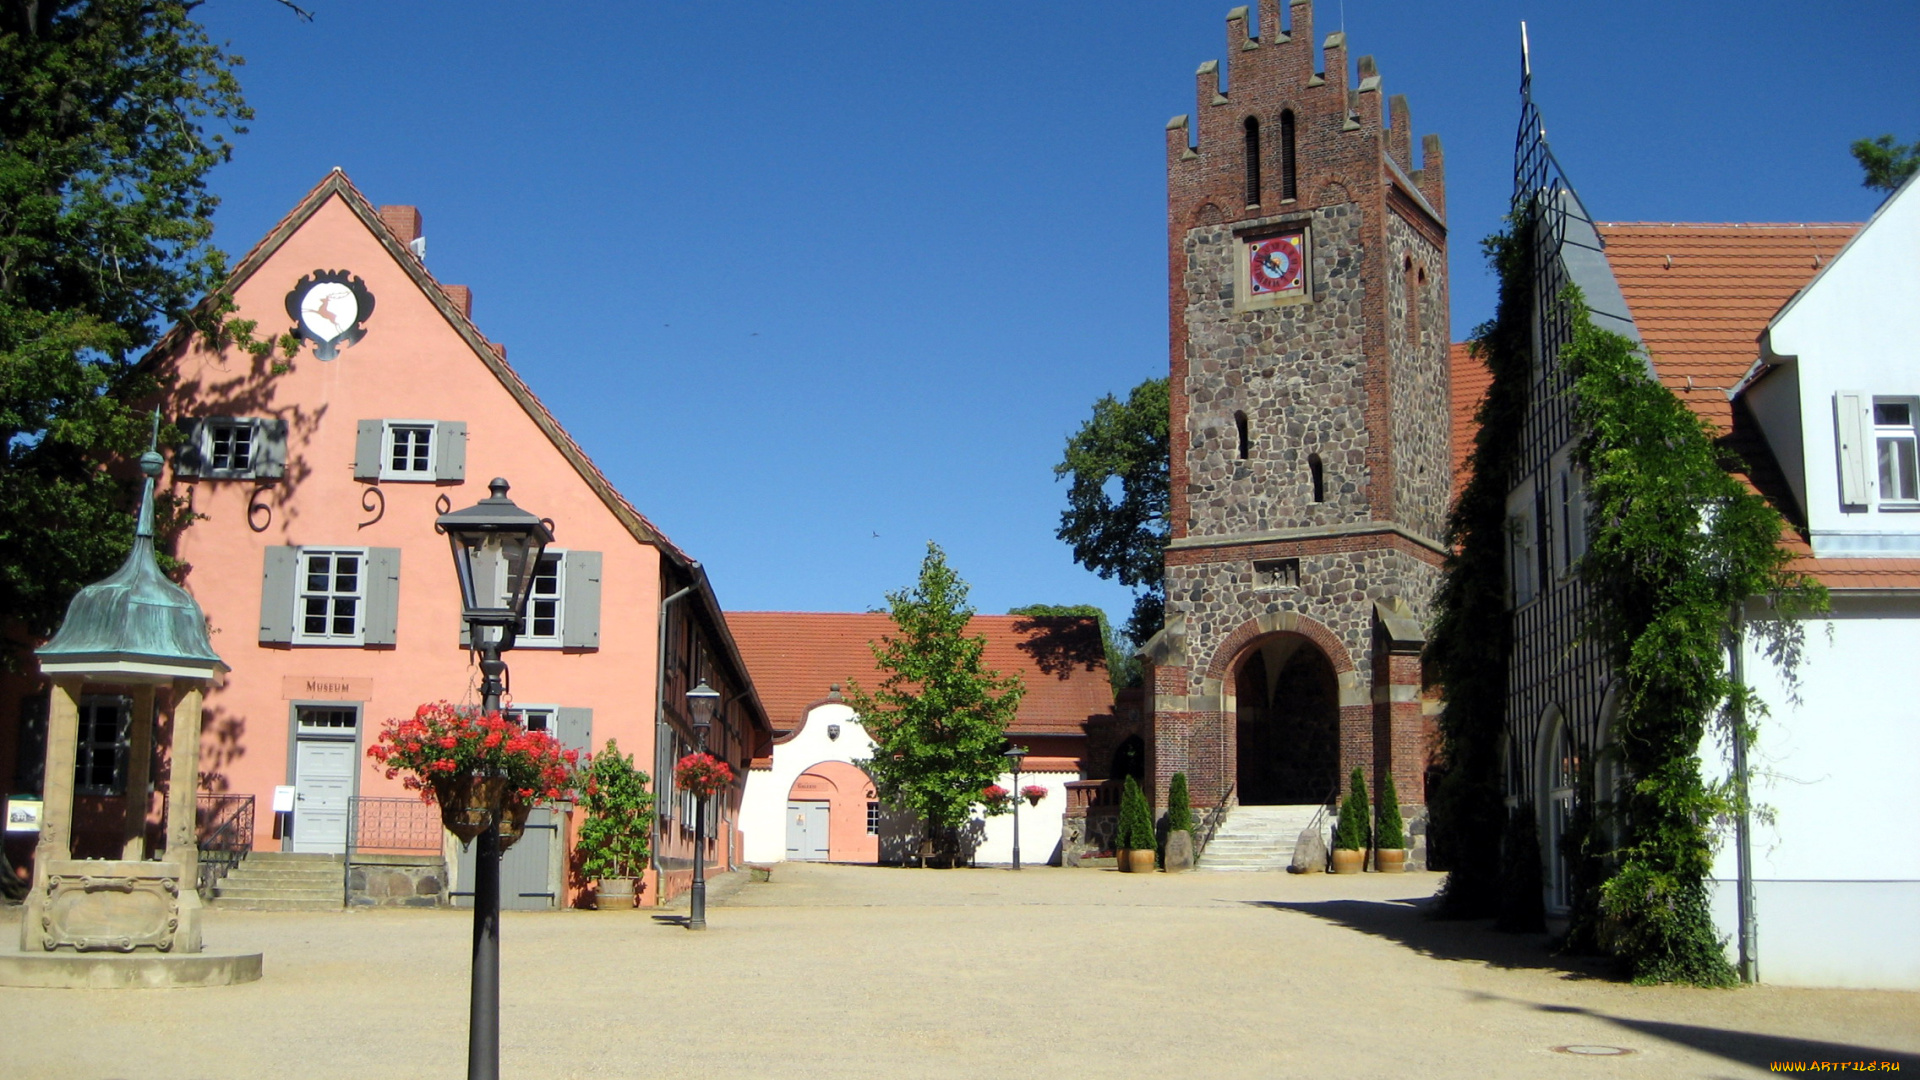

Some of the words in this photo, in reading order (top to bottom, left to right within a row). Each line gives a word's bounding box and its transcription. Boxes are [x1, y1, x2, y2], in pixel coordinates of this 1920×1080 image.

[247, 484, 275, 532] 6
[358, 487, 385, 530] 9
[306, 681, 349, 692] MUSEUM
